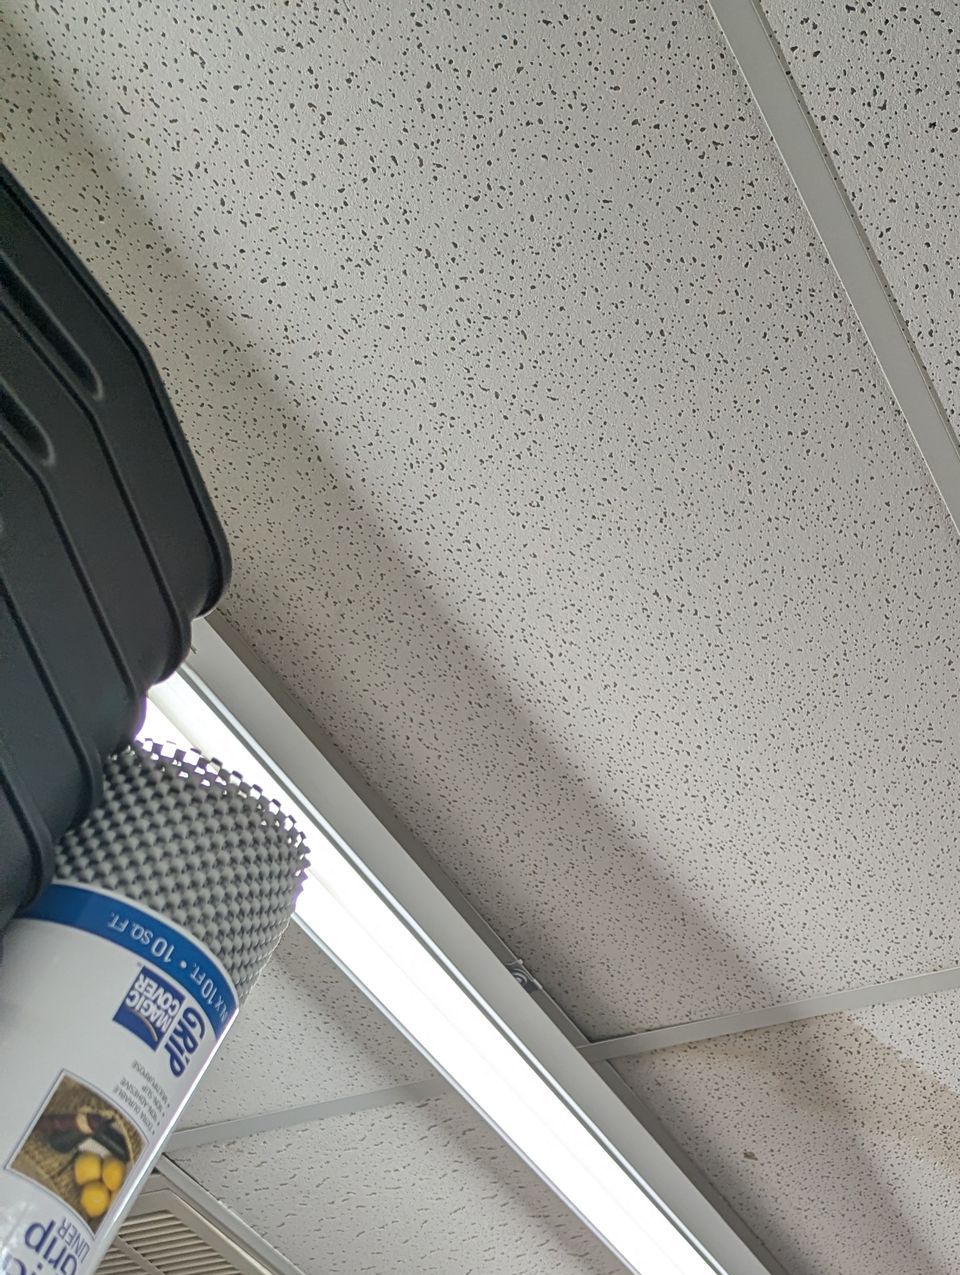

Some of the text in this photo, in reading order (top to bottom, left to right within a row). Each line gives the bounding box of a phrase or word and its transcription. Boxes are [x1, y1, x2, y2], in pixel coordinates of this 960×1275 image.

[107, 911, 129, 933] FT.
[130, 922, 154, 945] SQ.
[151, 937, 175, 963] 10
[189, 962, 206, 985] FT.
[134, 973, 180, 1018] COVER
[201, 978, 218, 1005] 10
[125, 990, 173, 1034] MAGIC
[57, 1217, 90, 1264] LINER
